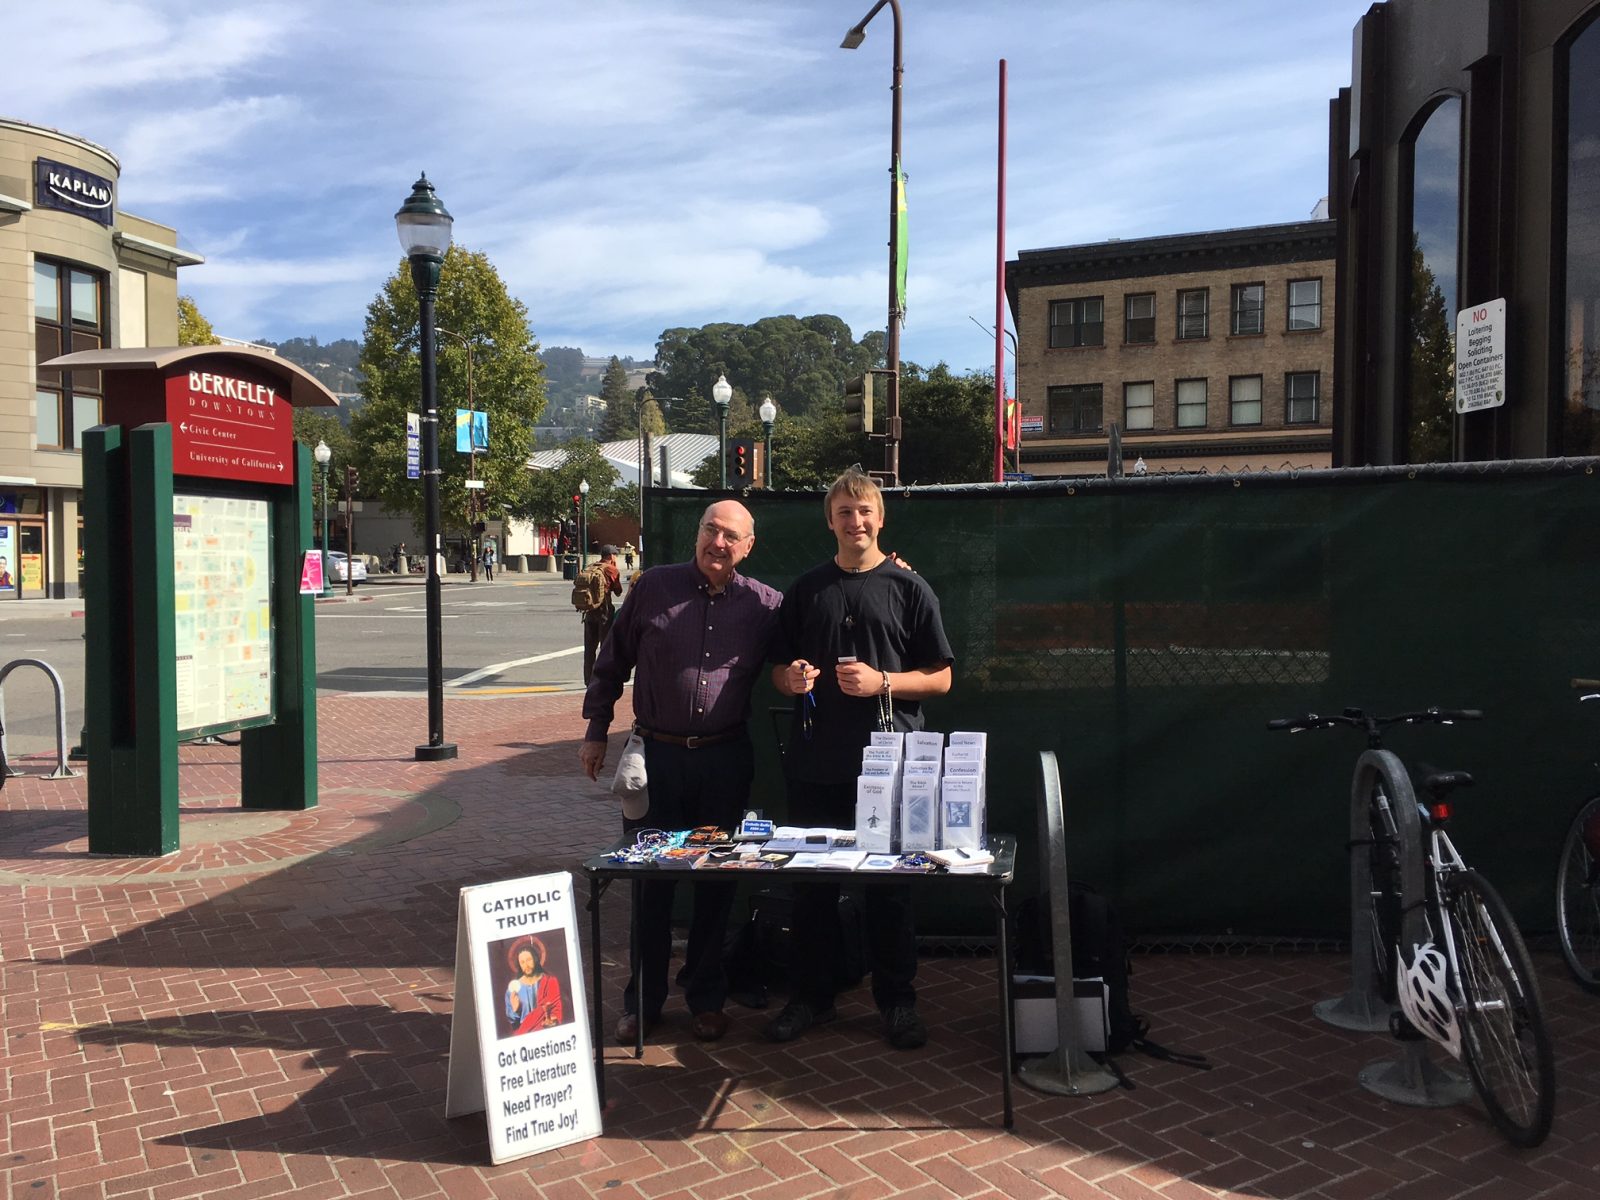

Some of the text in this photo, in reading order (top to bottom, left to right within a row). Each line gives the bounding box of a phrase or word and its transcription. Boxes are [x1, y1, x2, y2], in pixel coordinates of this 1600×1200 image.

[50, 173, 107, 202] KAPLAN
[1473, 308, 1488, 323] NO
[1468, 324, 1492, 336] Loitering
[1468, 345, 1492, 357] Soliciting
[1469, 335, 1491, 347] Begging
[1458, 353, 1503, 370] Open Containers
[189, 371, 276, 406] BERKELEY
[189, 397, 275, 421] DOWNTOWN
[189, 425, 236, 439] Civic Center
[190, 452, 228, 465] University
[242, 458, 276, 469] California
[483, 890, 561, 913] CATHOLIC
[496, 910, 549, 929] TRUTH
[498, 1035, 577, 1068] Got Questions?
[500, 1062, 576, 1092] Free Literature
[503, 1084, 572, 1117] Need Prayer?
[506, 1109, 578, 1144] Find True Joy!
